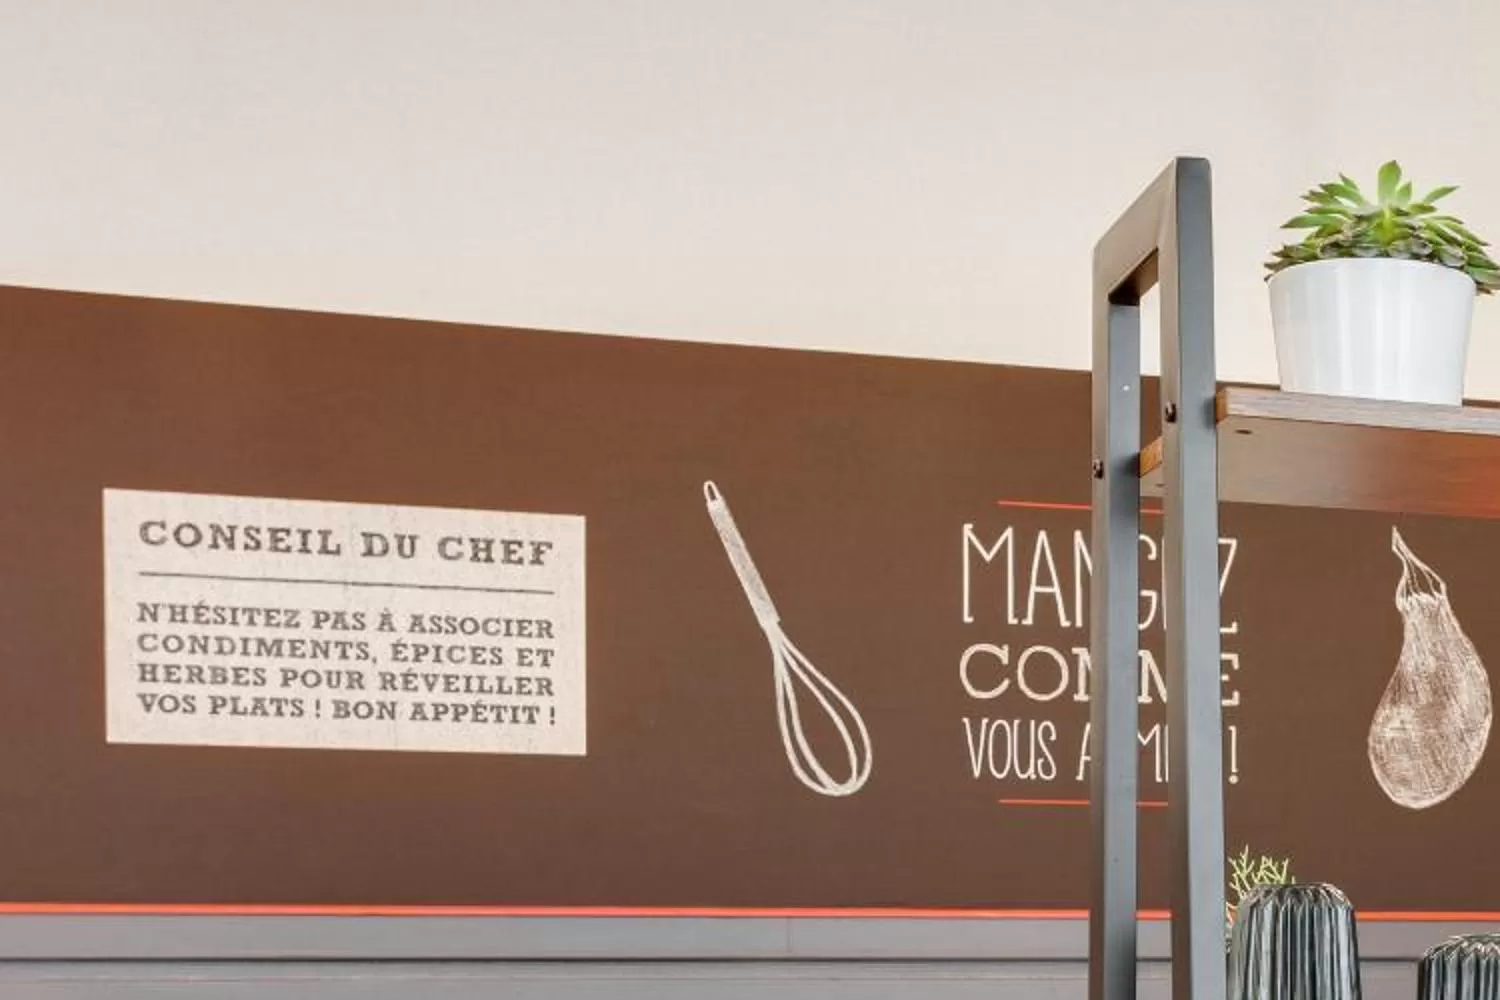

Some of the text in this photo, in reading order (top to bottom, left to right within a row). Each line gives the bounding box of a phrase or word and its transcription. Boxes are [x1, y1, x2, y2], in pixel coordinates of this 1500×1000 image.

[139, 520, 554, 566] CONSEIL DU CHEF
[311, 609, 367, 631] PAS
[377, 607, 397, 633] À
[408, 613, 555, 639] ASSOCIER
[137, 633, 555, 668] CONDIMENTS, ÉPICES ET
[137, 662, 555, 697] HERBES POUR RÉVEILLER
[137, 692, 197, 714] VOS
[208, 695, 305, 718] PLATS
[332, 699, 397, 721] BON
[409, 698, 541, 725] APPÉTIT
[962, 717, 1057, 781] VOUS
